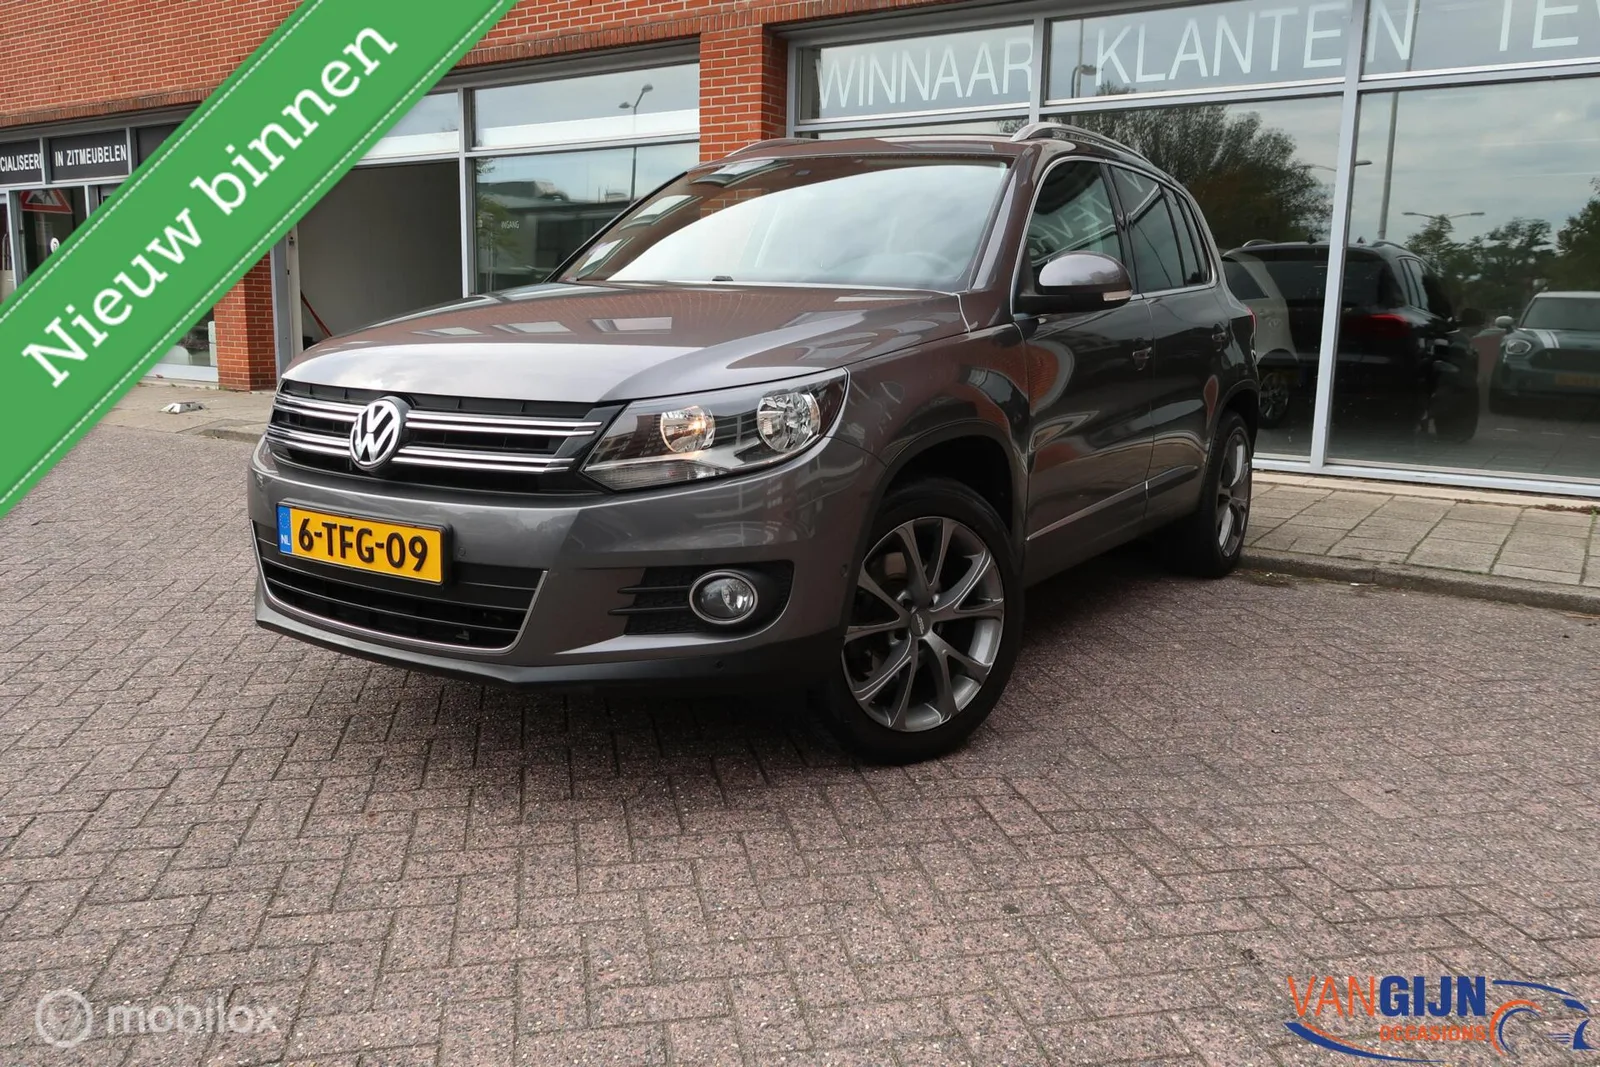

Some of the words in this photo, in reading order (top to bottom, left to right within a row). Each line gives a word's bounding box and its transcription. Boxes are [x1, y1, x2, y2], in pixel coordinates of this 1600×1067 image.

[815, 37, 1033, 110] WINNAAR
[1499, 0, 1600, 51] TE
[55, 151, 64, 167] IN
[66, 144, 127, 166] ZITMEUBELEN
[280, 534, 291, 546] NL
[298, 517, 428, 572] 6-TFG-09
